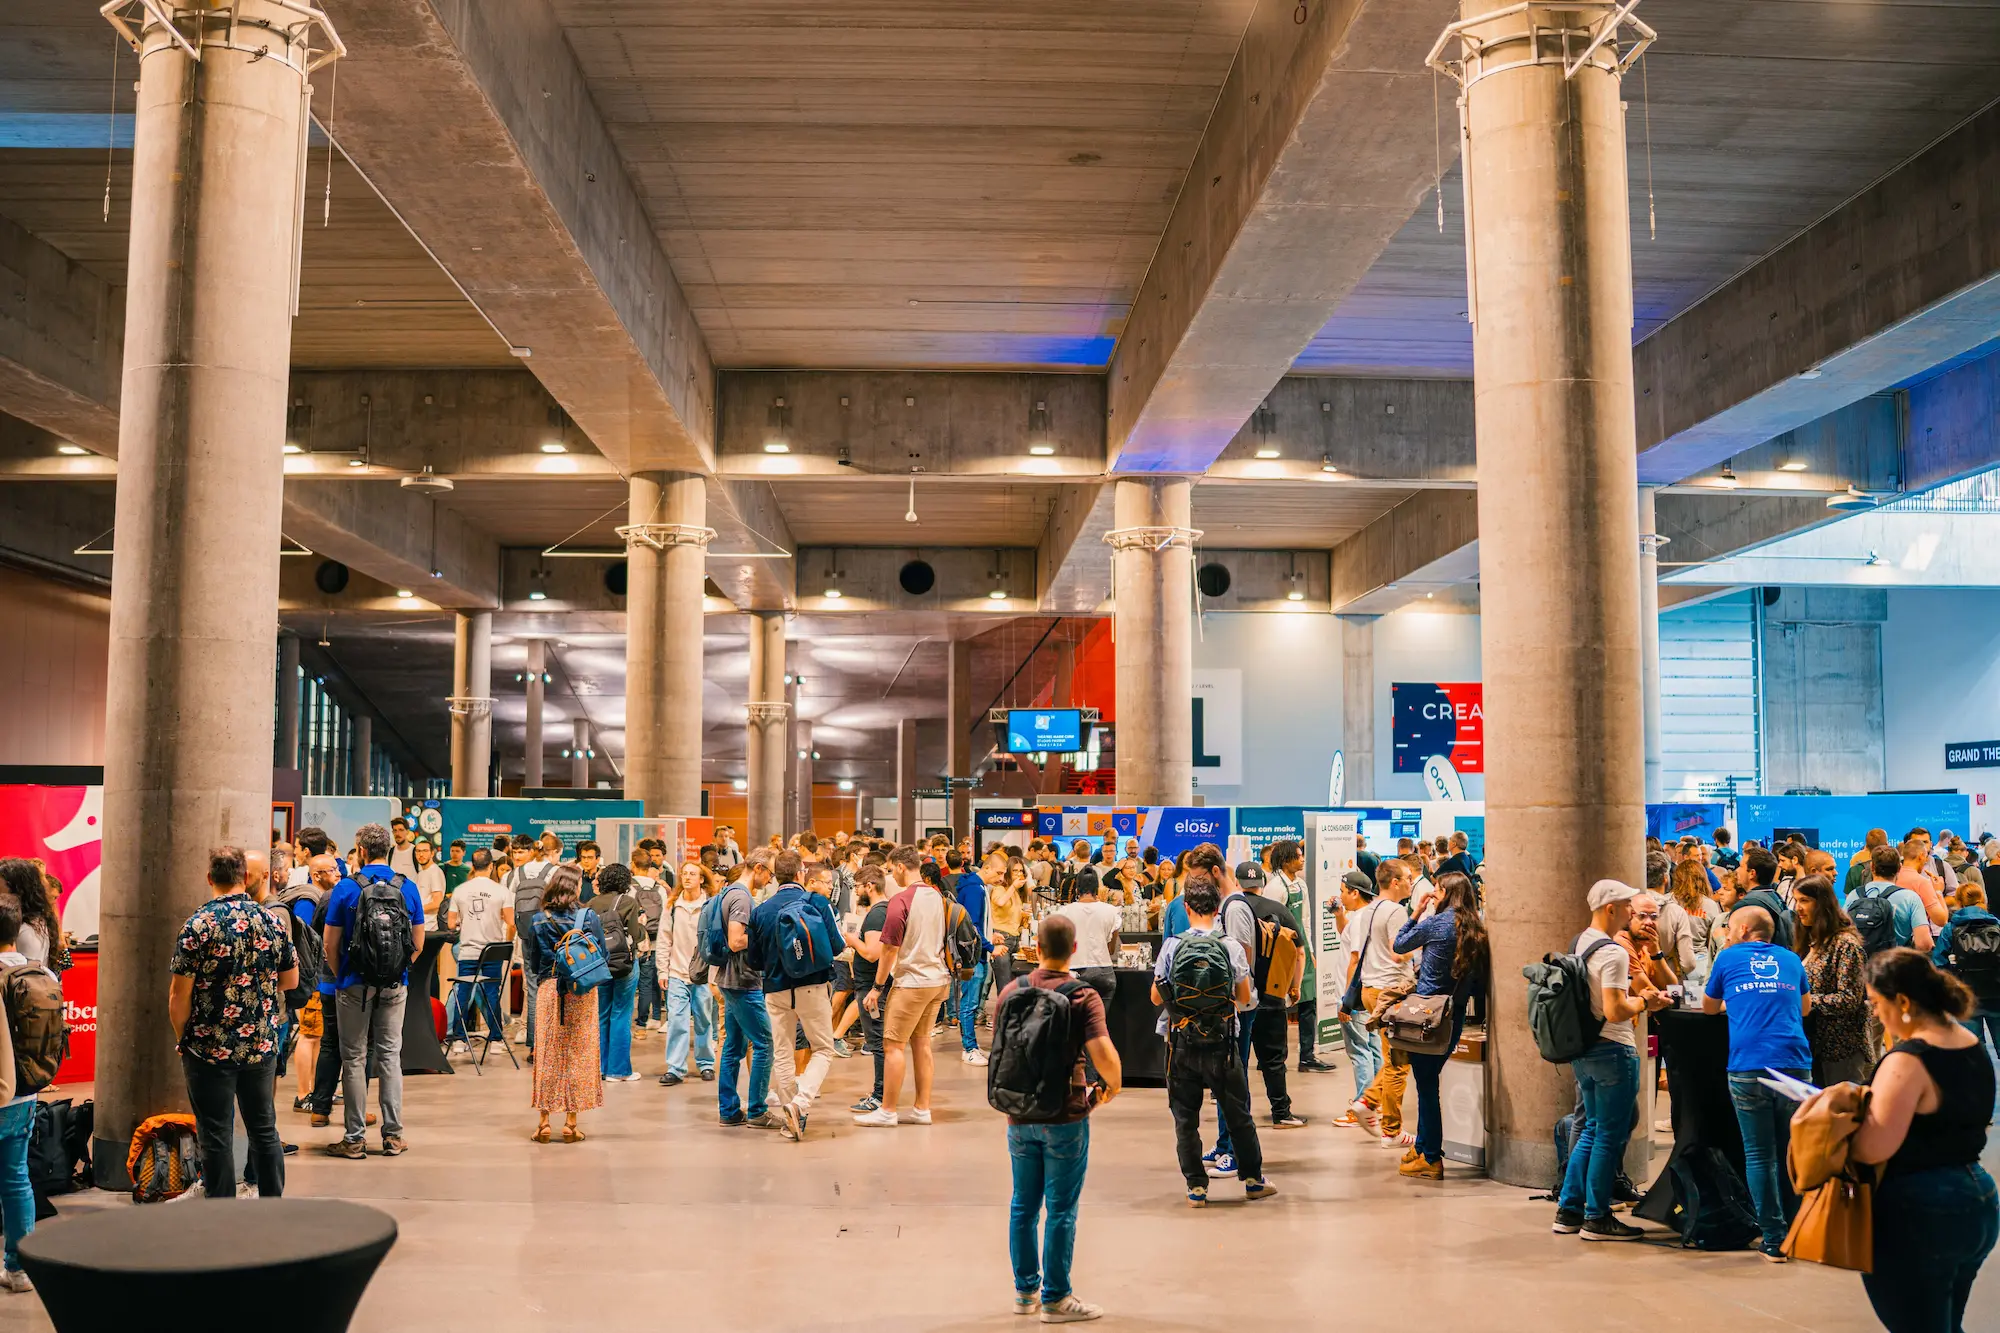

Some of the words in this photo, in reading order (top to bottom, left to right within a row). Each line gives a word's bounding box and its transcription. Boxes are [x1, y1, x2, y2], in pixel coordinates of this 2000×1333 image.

[1948, 748, 1980, 763] GRAND
[1982, 746, 2000, 761] THE
[1272, 833, 1302, 842] positive
[1850, 838, 1864, 848] les
[70, 1023, 97, 1033] CHOO
